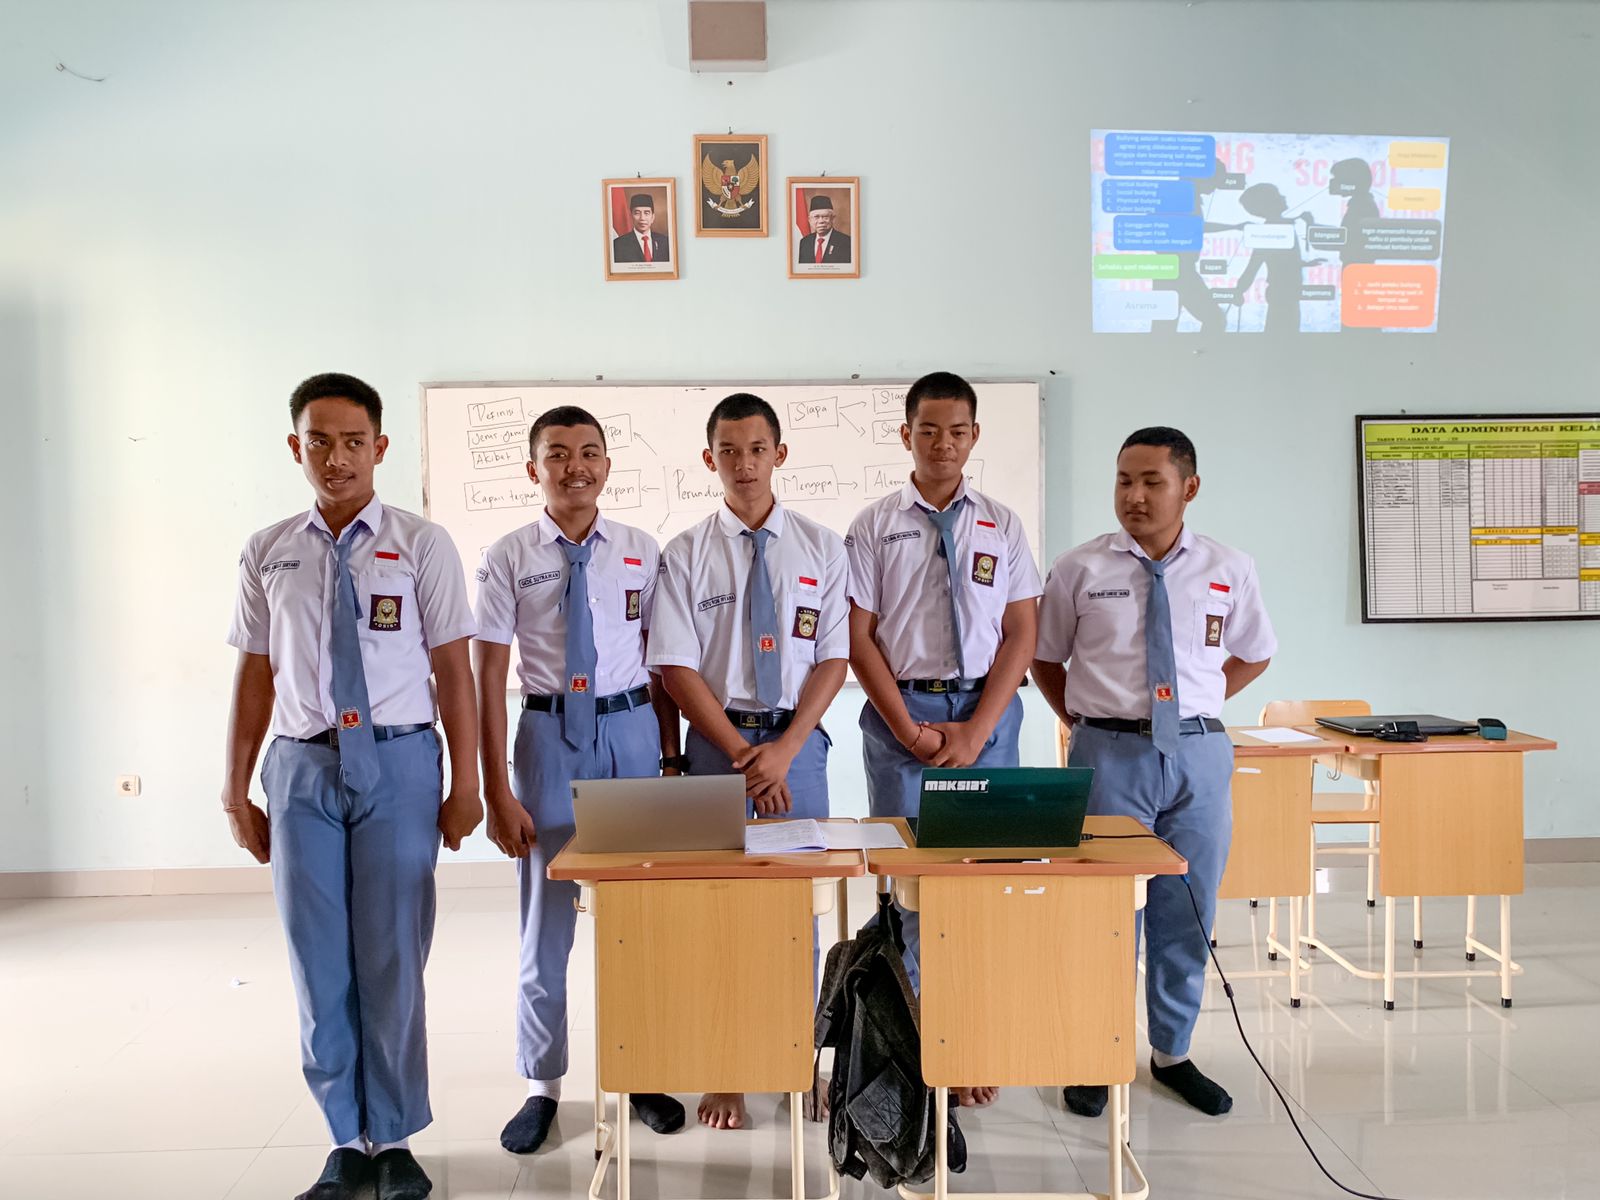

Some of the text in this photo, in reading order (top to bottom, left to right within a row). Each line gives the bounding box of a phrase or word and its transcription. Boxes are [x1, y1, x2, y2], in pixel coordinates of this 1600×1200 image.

[1295, 160, 1403, 187] SCOL
[1411, 426, 1446, 434] DATA
[1452, 425, 1554, 434] ADMINISTRASI
[600, 486, 635, 502] apan
